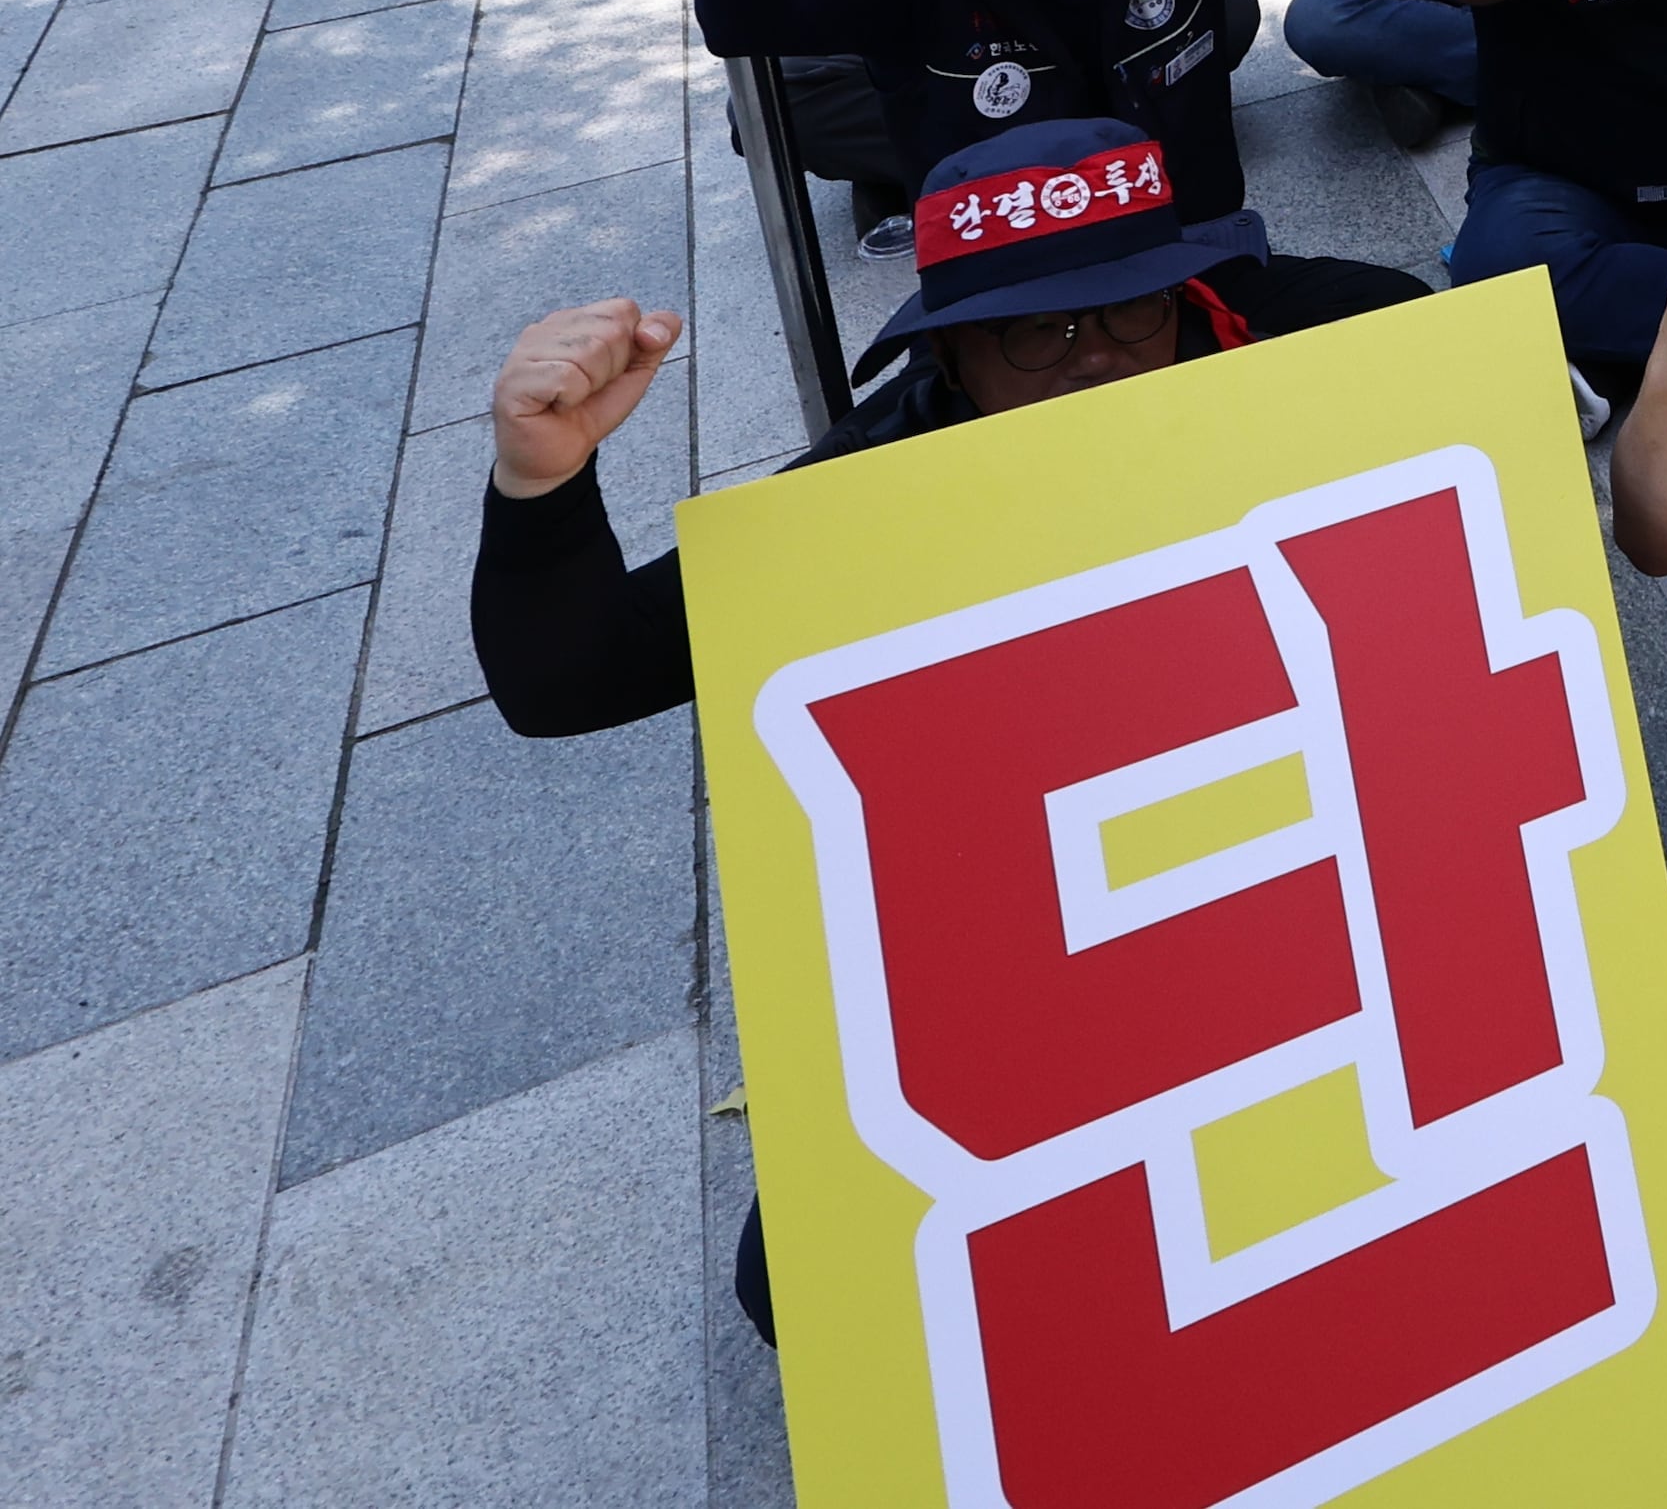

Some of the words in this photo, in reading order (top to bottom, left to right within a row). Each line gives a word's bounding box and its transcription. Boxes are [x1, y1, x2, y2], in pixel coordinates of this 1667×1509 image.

[949, 181, 1036, 240] 단결
[1095, 153, 1162, 205] 투쟁
[795, 475, 1631, 1509] 단
